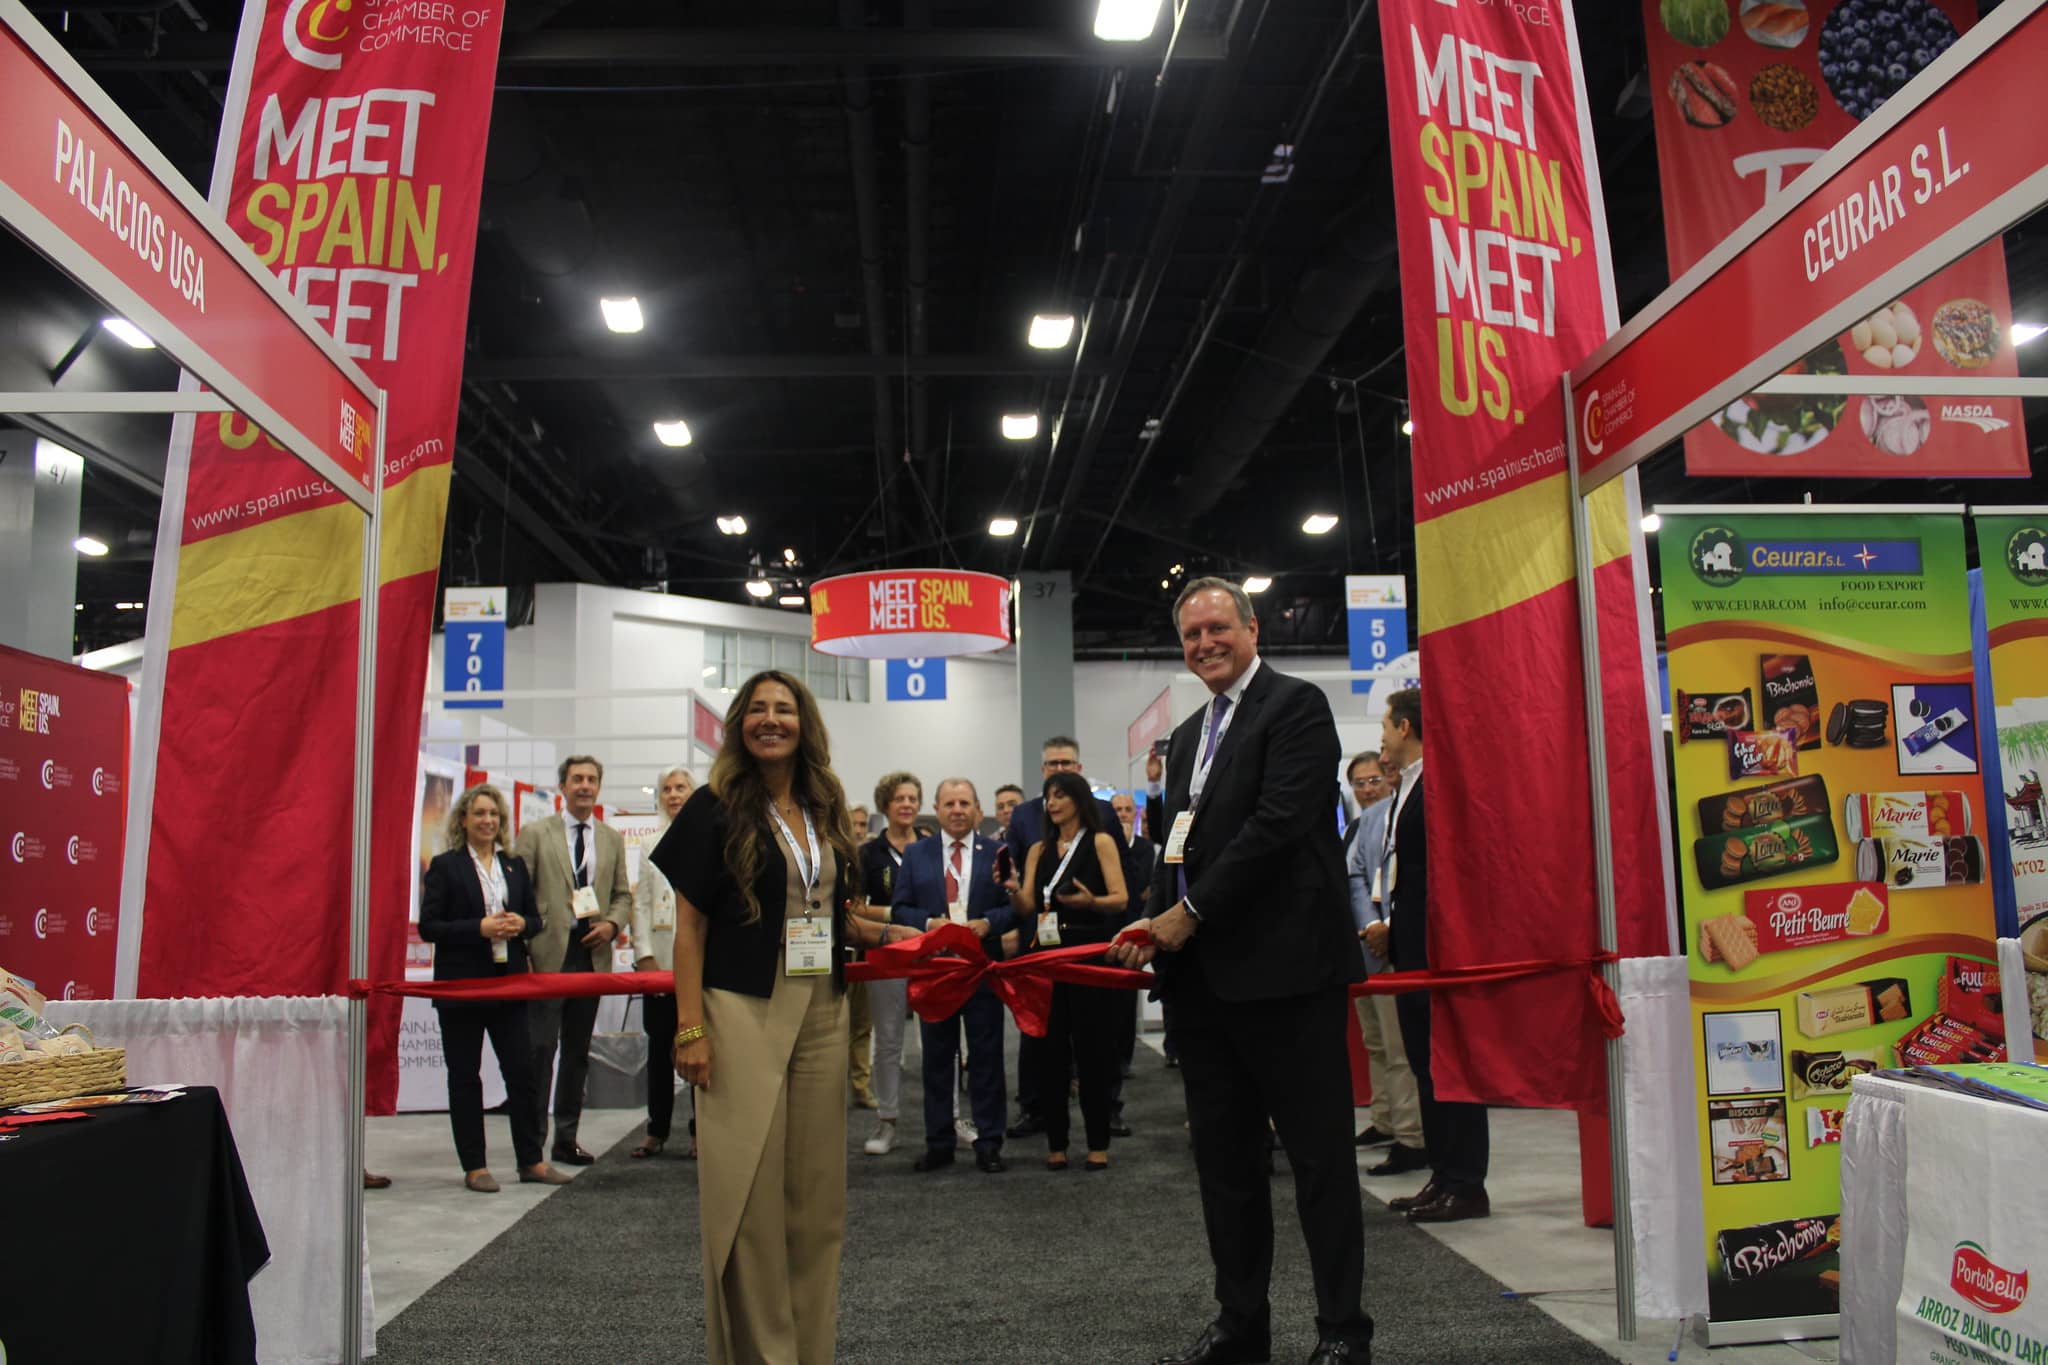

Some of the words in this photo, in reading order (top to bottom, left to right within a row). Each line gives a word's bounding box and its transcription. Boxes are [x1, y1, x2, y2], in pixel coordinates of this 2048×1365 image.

[362, 1, 455, 31] CHAMBER
[462, 8, 491, 28] OF
[359, 25, 473, 52] COMMERCE
[1410, 23, 1544, 151] MEET
[253, 88, 436, 181] MEET
[55, 118, 165, 274] PALACIOS
[169, 229, 206, 314] USA
[1802, 164, 1906, 283] CEURAR
[1910, 126, 1971, 207] S.L.
[1428, 217, 1561, 337] MEET
[269, 267, 418, 362] EET
[1436, 317, 1525, 425] US.
[1941, 405, 1994, 417] NASDA
[868, 579, 916, 605] MEET
[1035, 582, 1056, 598] 37
[1841, 581, 1875, 591] FOOD
[1878, 581, 1926, 591] EXPORT
[869, 604, 917, 630] MEET
[1692, 600, 1808, 611] WWW.CEURAR.COM
[1818, 597, 1927, 612] info@ceurar.com
[20, 688, 39, 710] MEET
[19, 709, 38, 733] MEET
[1875, 806, 1922, 823] Marie
[1891, 848, 1939, 864] Marie
[1769, 911, 1806, 937] Petit
[1807, 908, 1850, 932] Beurre
[400, 1039, 442, 1051] HAMBE
[1956, 1256, 2025, 1302] PortoBello
[1915, 1295, 1960, 1331] ARROZ
[1961, 1312, 2012, 1353] BLANCO
